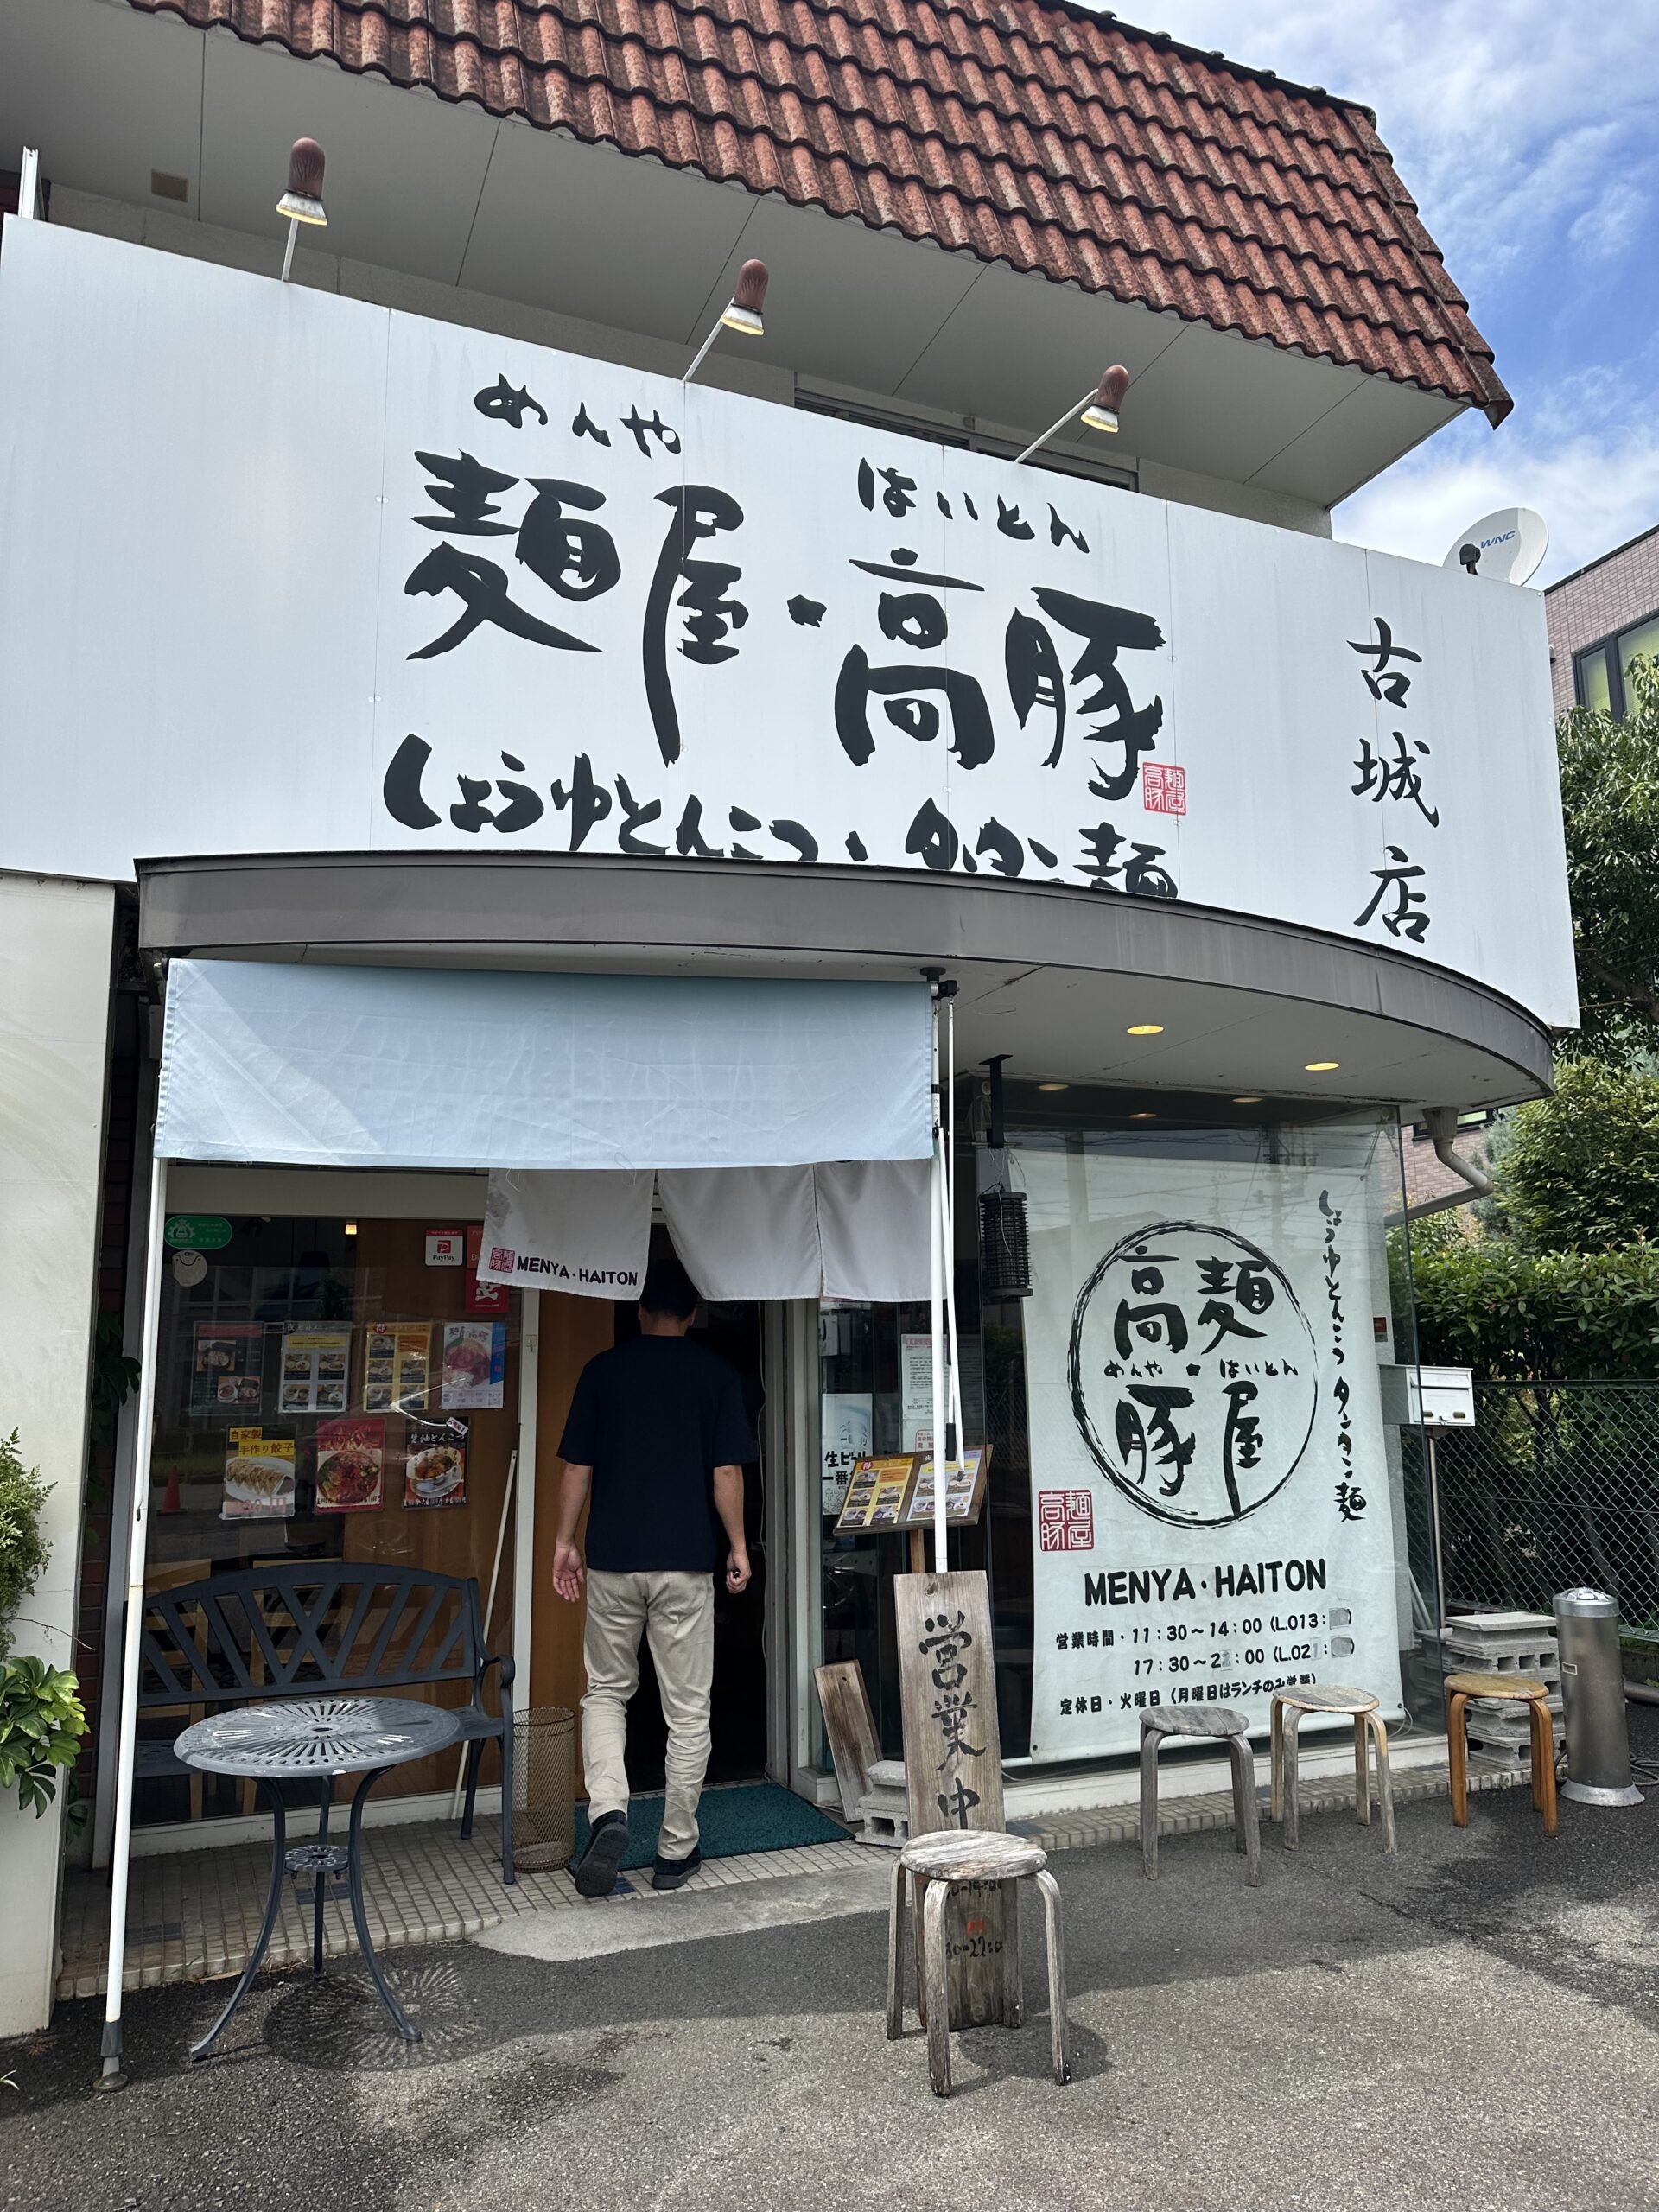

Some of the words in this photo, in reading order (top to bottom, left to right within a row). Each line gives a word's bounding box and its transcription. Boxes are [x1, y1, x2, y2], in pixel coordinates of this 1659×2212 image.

[474, 373, 681, 458] めんや
[858, 456, 1090, 555] はいとん
[1480, 530, 1516, 549] WNC
[404, 448, 1167, 801] 麺屋・高豚
[1346, 616, 1440, 944] 古城店
[1319, 1189, 1344, 1366] しょうゆとんこつ
[231, 1429, 262, 1440] 自家製
[239, 1442, 294, 1455] 手作り餃子
[823, 1471, 853, 1485] 一番
[918, 1610, 987, 1830] 営業中
